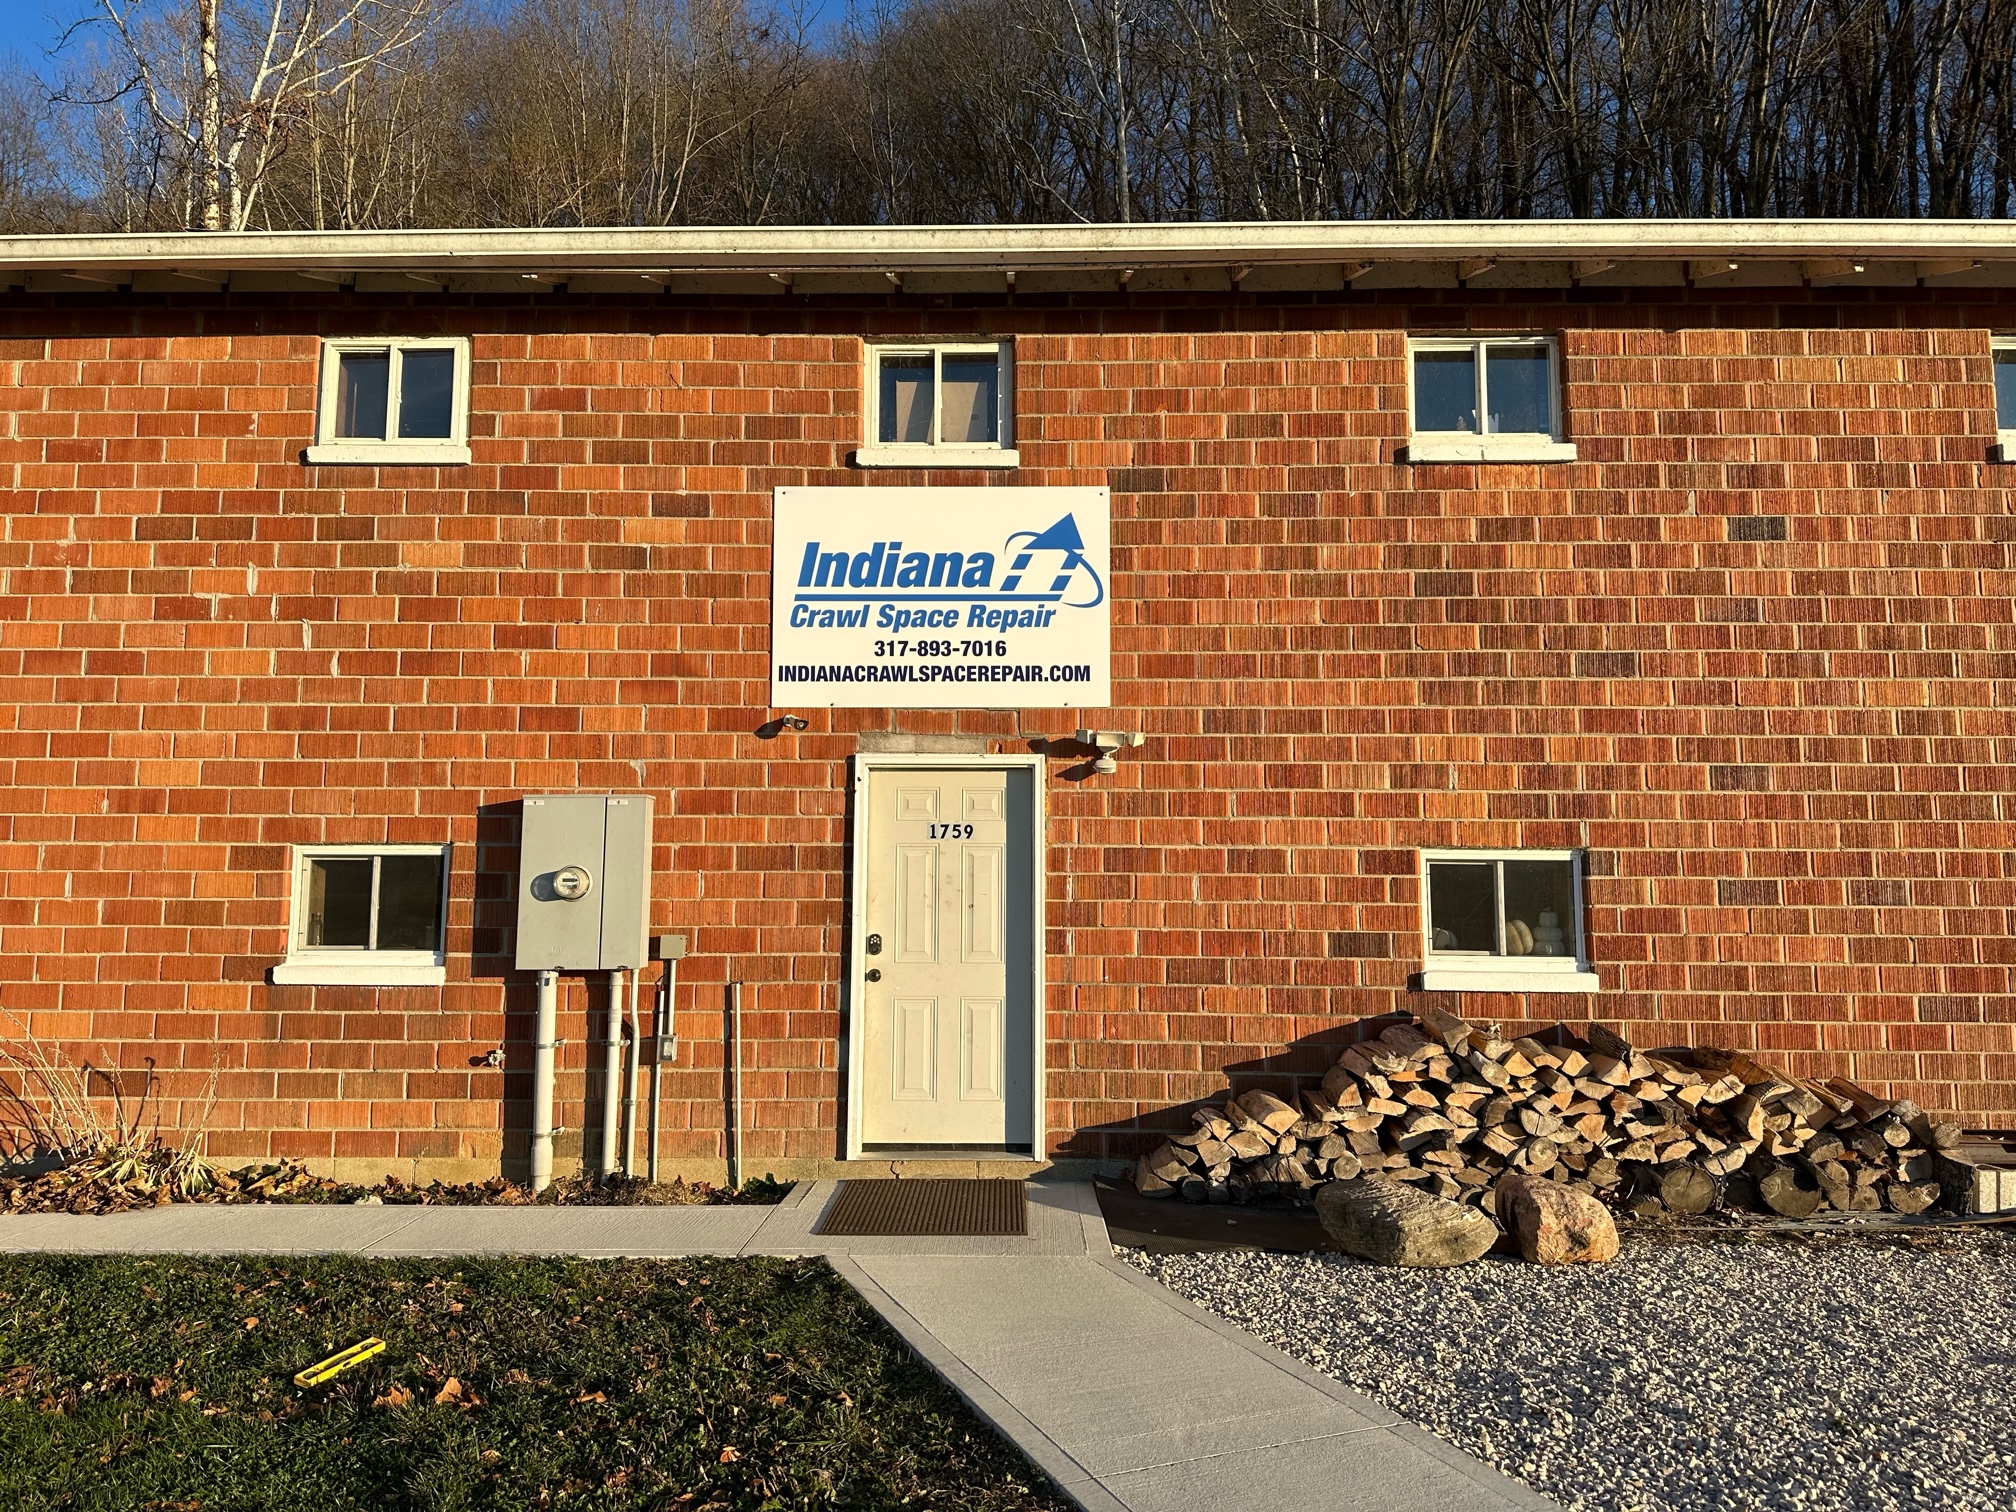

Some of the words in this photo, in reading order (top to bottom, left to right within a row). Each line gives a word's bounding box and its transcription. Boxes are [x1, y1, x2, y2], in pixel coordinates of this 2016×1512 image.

[797, 541, 995, 589] Indiana
[790, 603, 870, 628] Crawl
[877, 603, 959, 634] Space
[967, 603, 1057, 634] Repair
[874, 640, 1007, 657] 317-893-7016
[778, 664, 1091, 683] INDIANACRAWLSPACEREPAIR.COM
[929, 823, 974, 840] 1759
